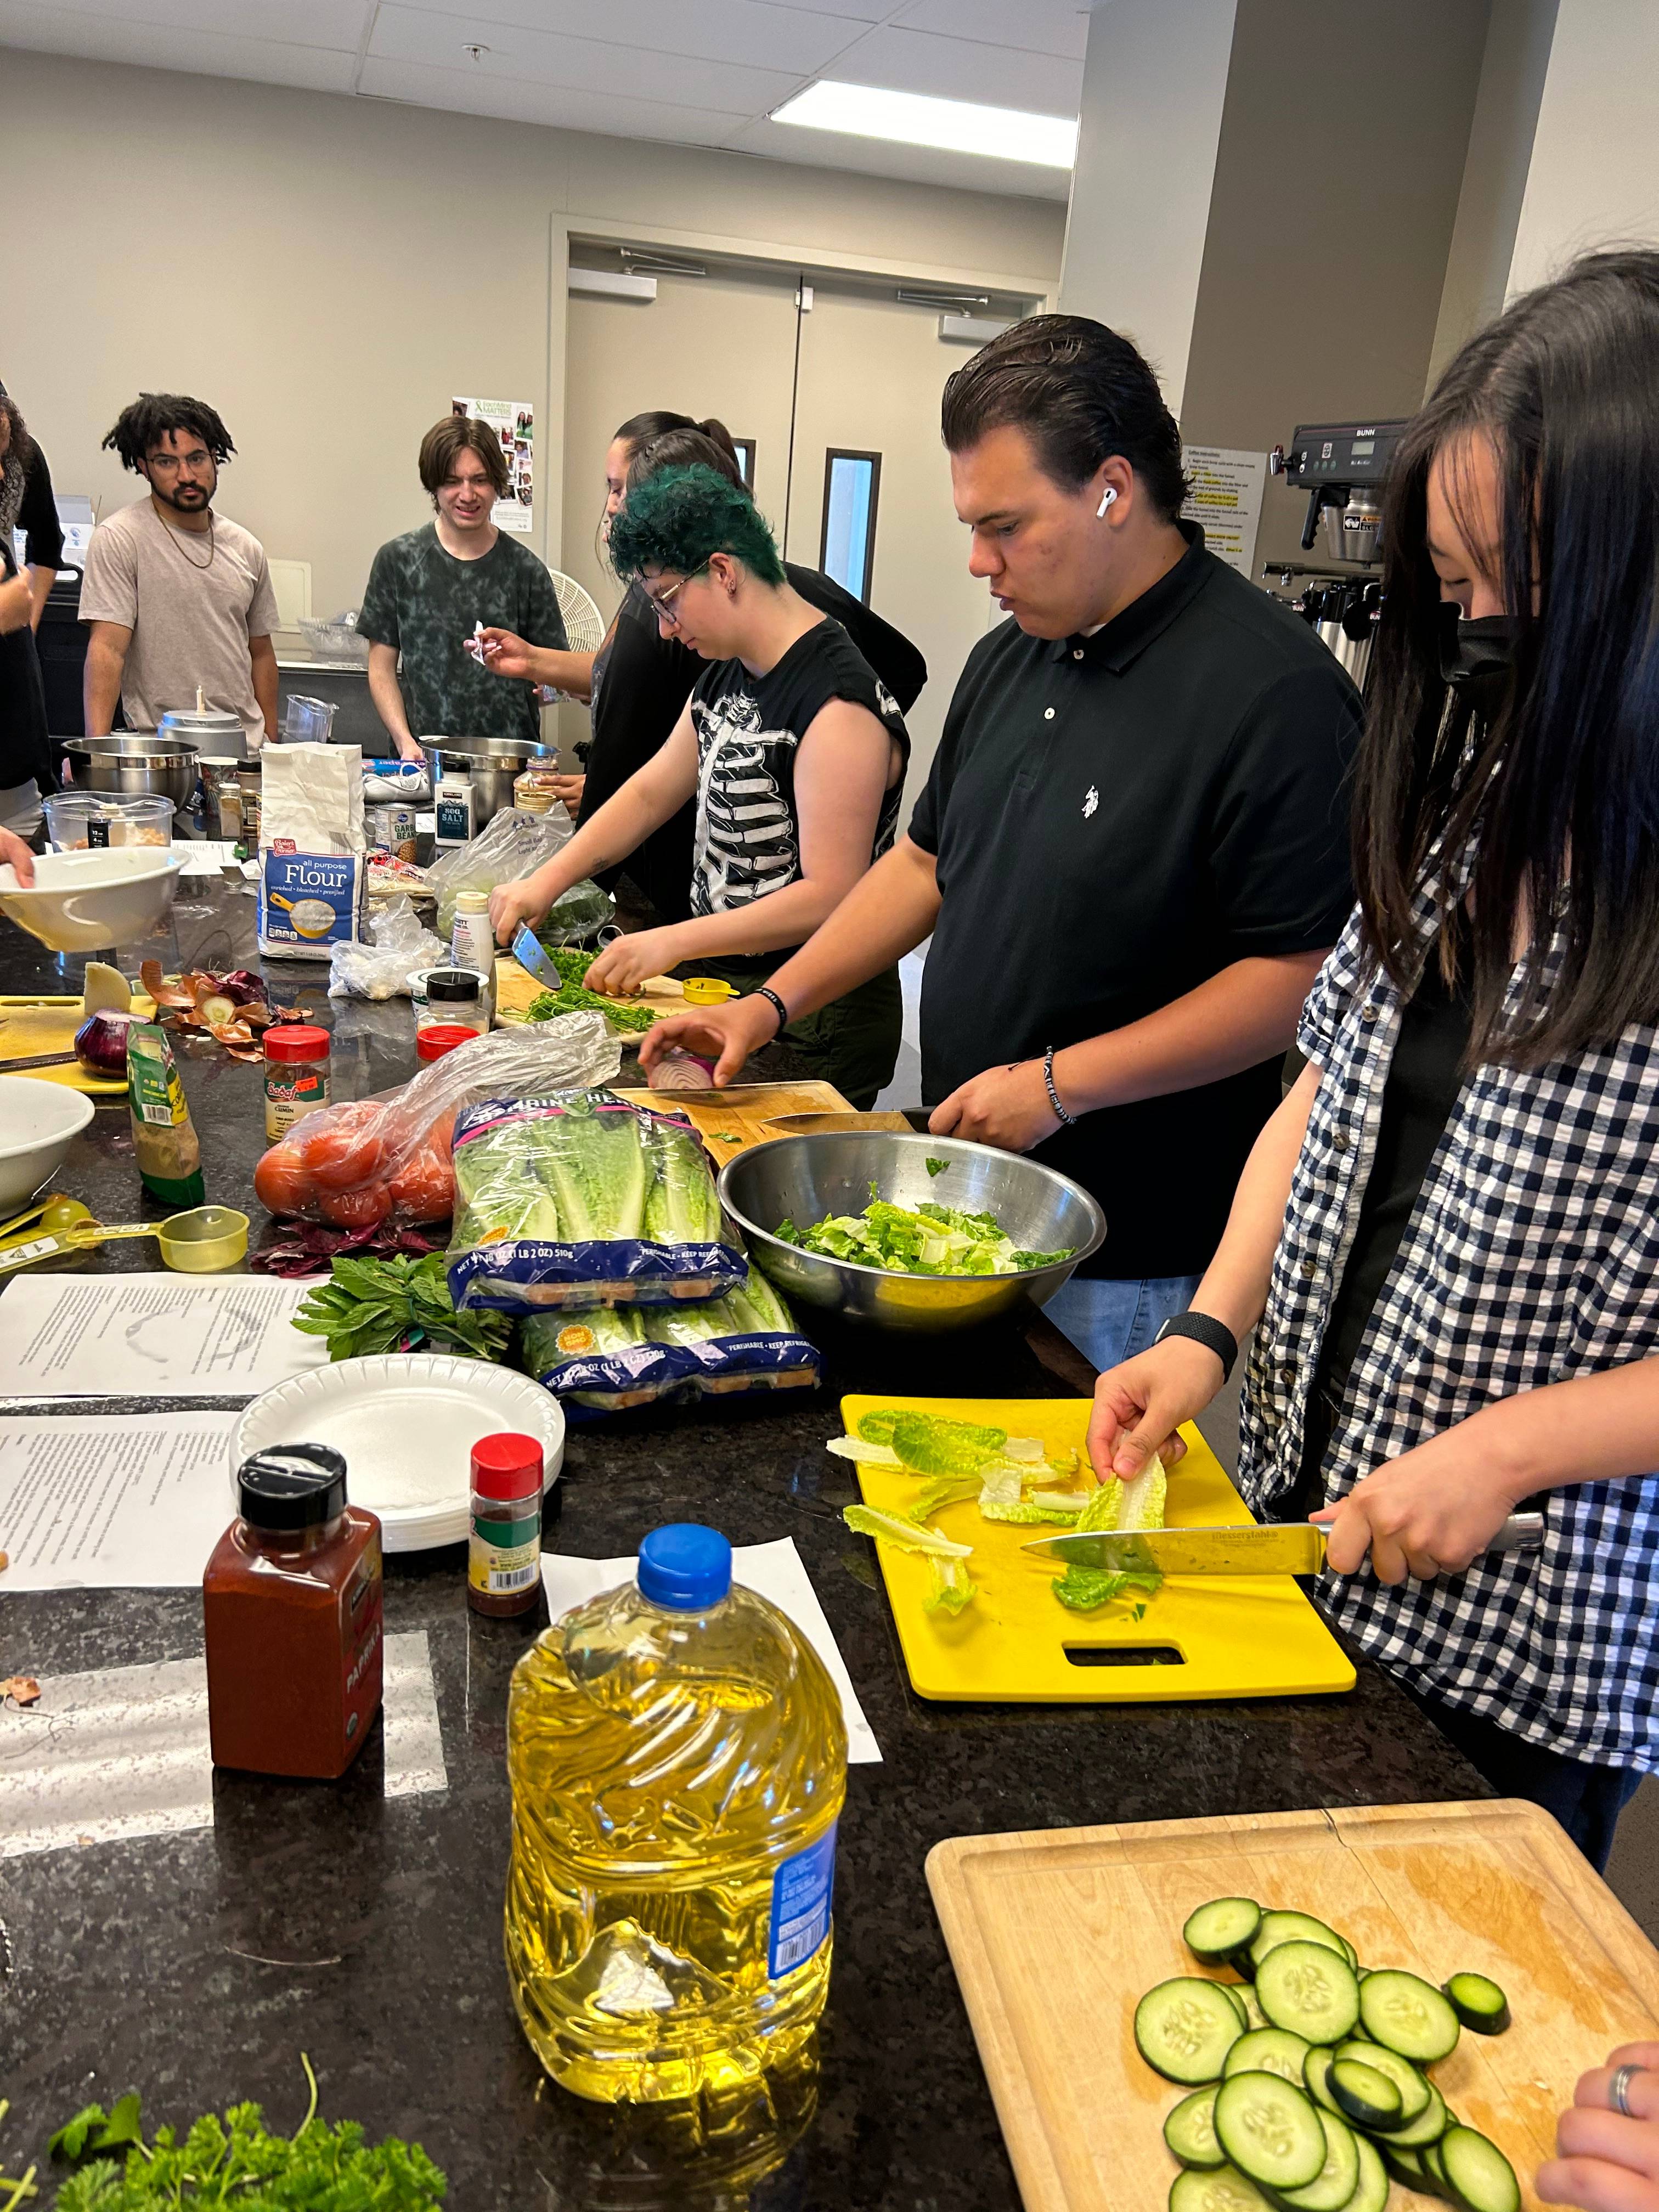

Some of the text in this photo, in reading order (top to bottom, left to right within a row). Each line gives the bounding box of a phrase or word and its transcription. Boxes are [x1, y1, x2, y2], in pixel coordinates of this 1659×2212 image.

[442, 813, 464, 822] SALT
[397, 832, 416, 840] BEAN
[274, 848, 295, 856] Corner
[314, 862, 347, 870] purpose
[284, 864, 347, 887] Flour
[268, 1081, 297, 1102] Sadaf
[33, 1244, 43, 1252] 1
[641, 1248, 677, 1260] PERISHABLE
[456, 1259, 470, 1274] NET
[518, 1249, 529, 1259] LB
[531, 1249, 537, 1259] 2
[538, 1248, 553, 1258] OZ)
[554, 1249, 574, 1259] 510g
[563, 1331, 585, 1341] NON
[566, 1336, 587, 1346] GMO
[729, 1342, 765, 1351] PERISHABLE
[768, 1341, 783, 1350] KEEP
[546, 1374, 561, 1389] NET
[588, 1363, 600, 1372] OZ
[610, 1360, 622, 1370] LB
[347, 1622, 380, 1694] PAPRIKA
